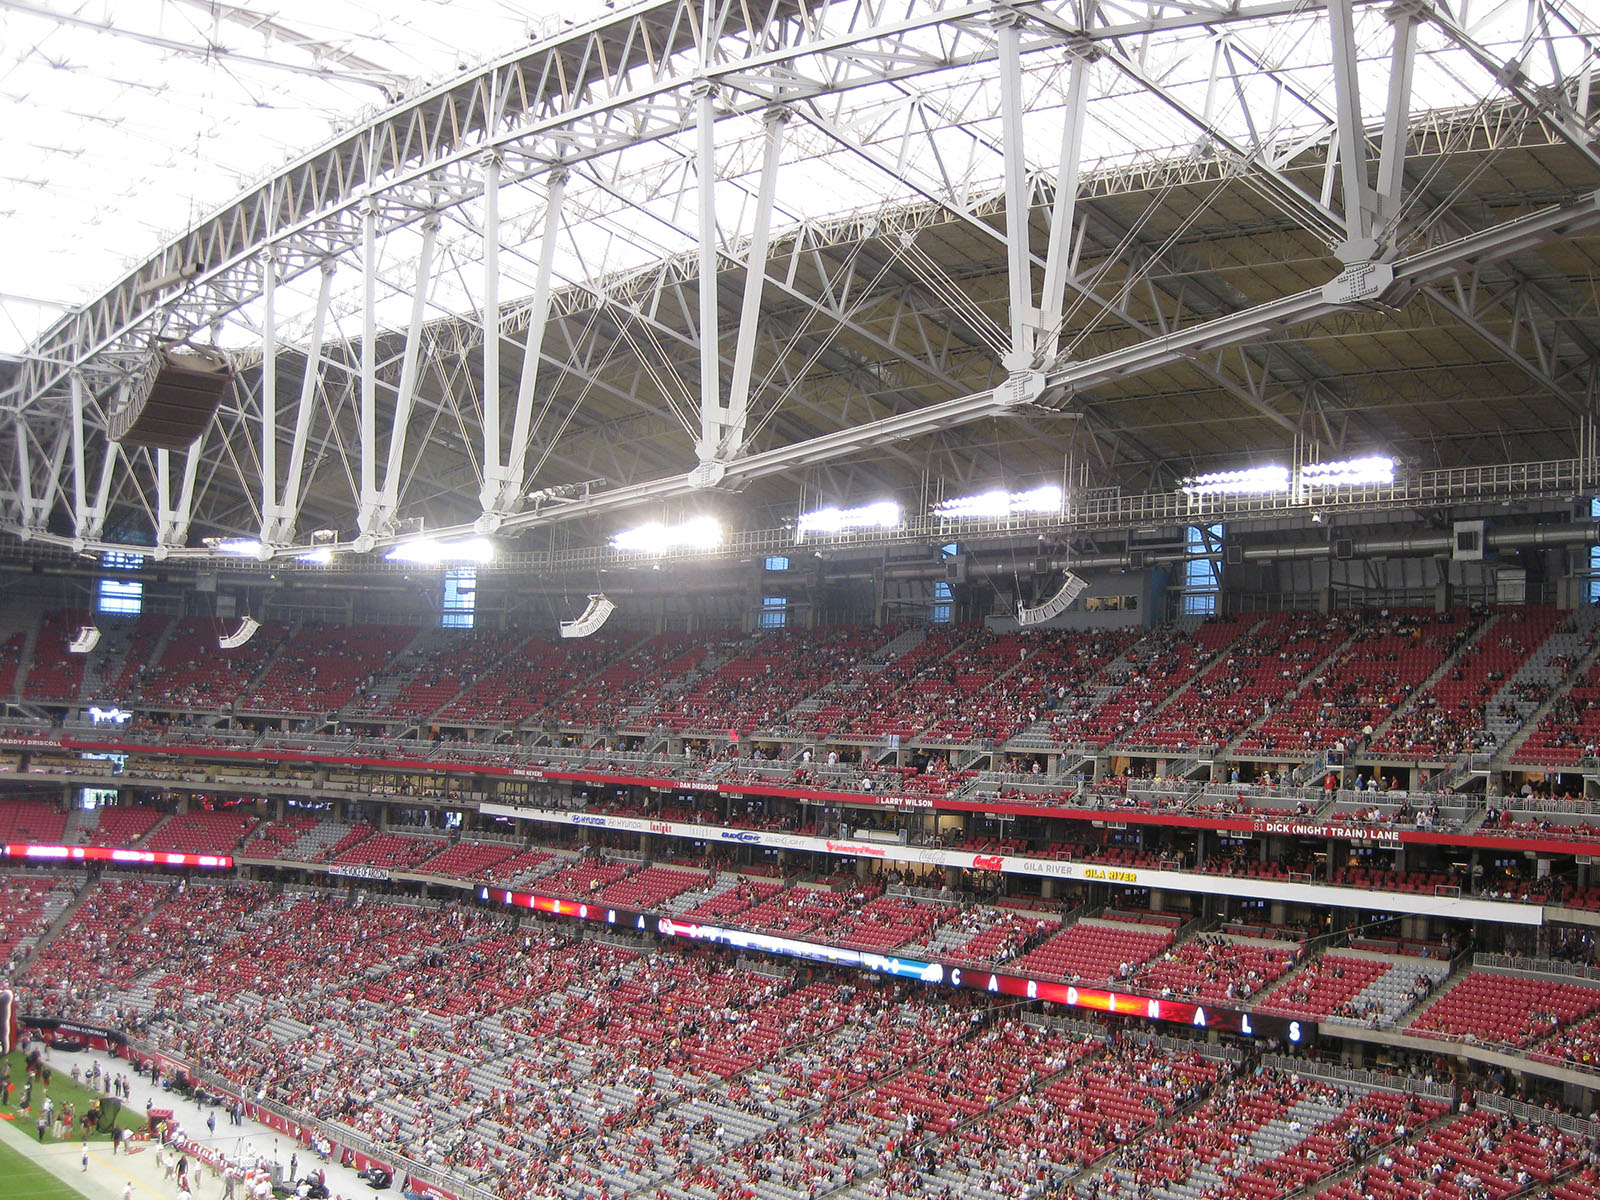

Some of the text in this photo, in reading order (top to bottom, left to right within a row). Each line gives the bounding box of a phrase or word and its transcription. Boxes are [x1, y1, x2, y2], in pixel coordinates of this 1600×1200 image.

[679, 781, 691, 789] DAN
[691, 782, 719, 791] DIERDORF
[880, 797, 904, 806] LARRY
[904, 798, 933, 808] WILSON
[581, 816, 606, 825] HYUNDAI
[616, 819, 642, 829] HYUNDAI
[721, 831, 738, 839] BUD
[1253, 822, 1399, 841] 81 DICK (NIGHT TRAIN) LANE
[1023, 861, 1073, 875] GILA RIVER
[1083, 868, 1137, 882] GILA RIVER
[951, 963, 1301, 1042] CARDINALS
